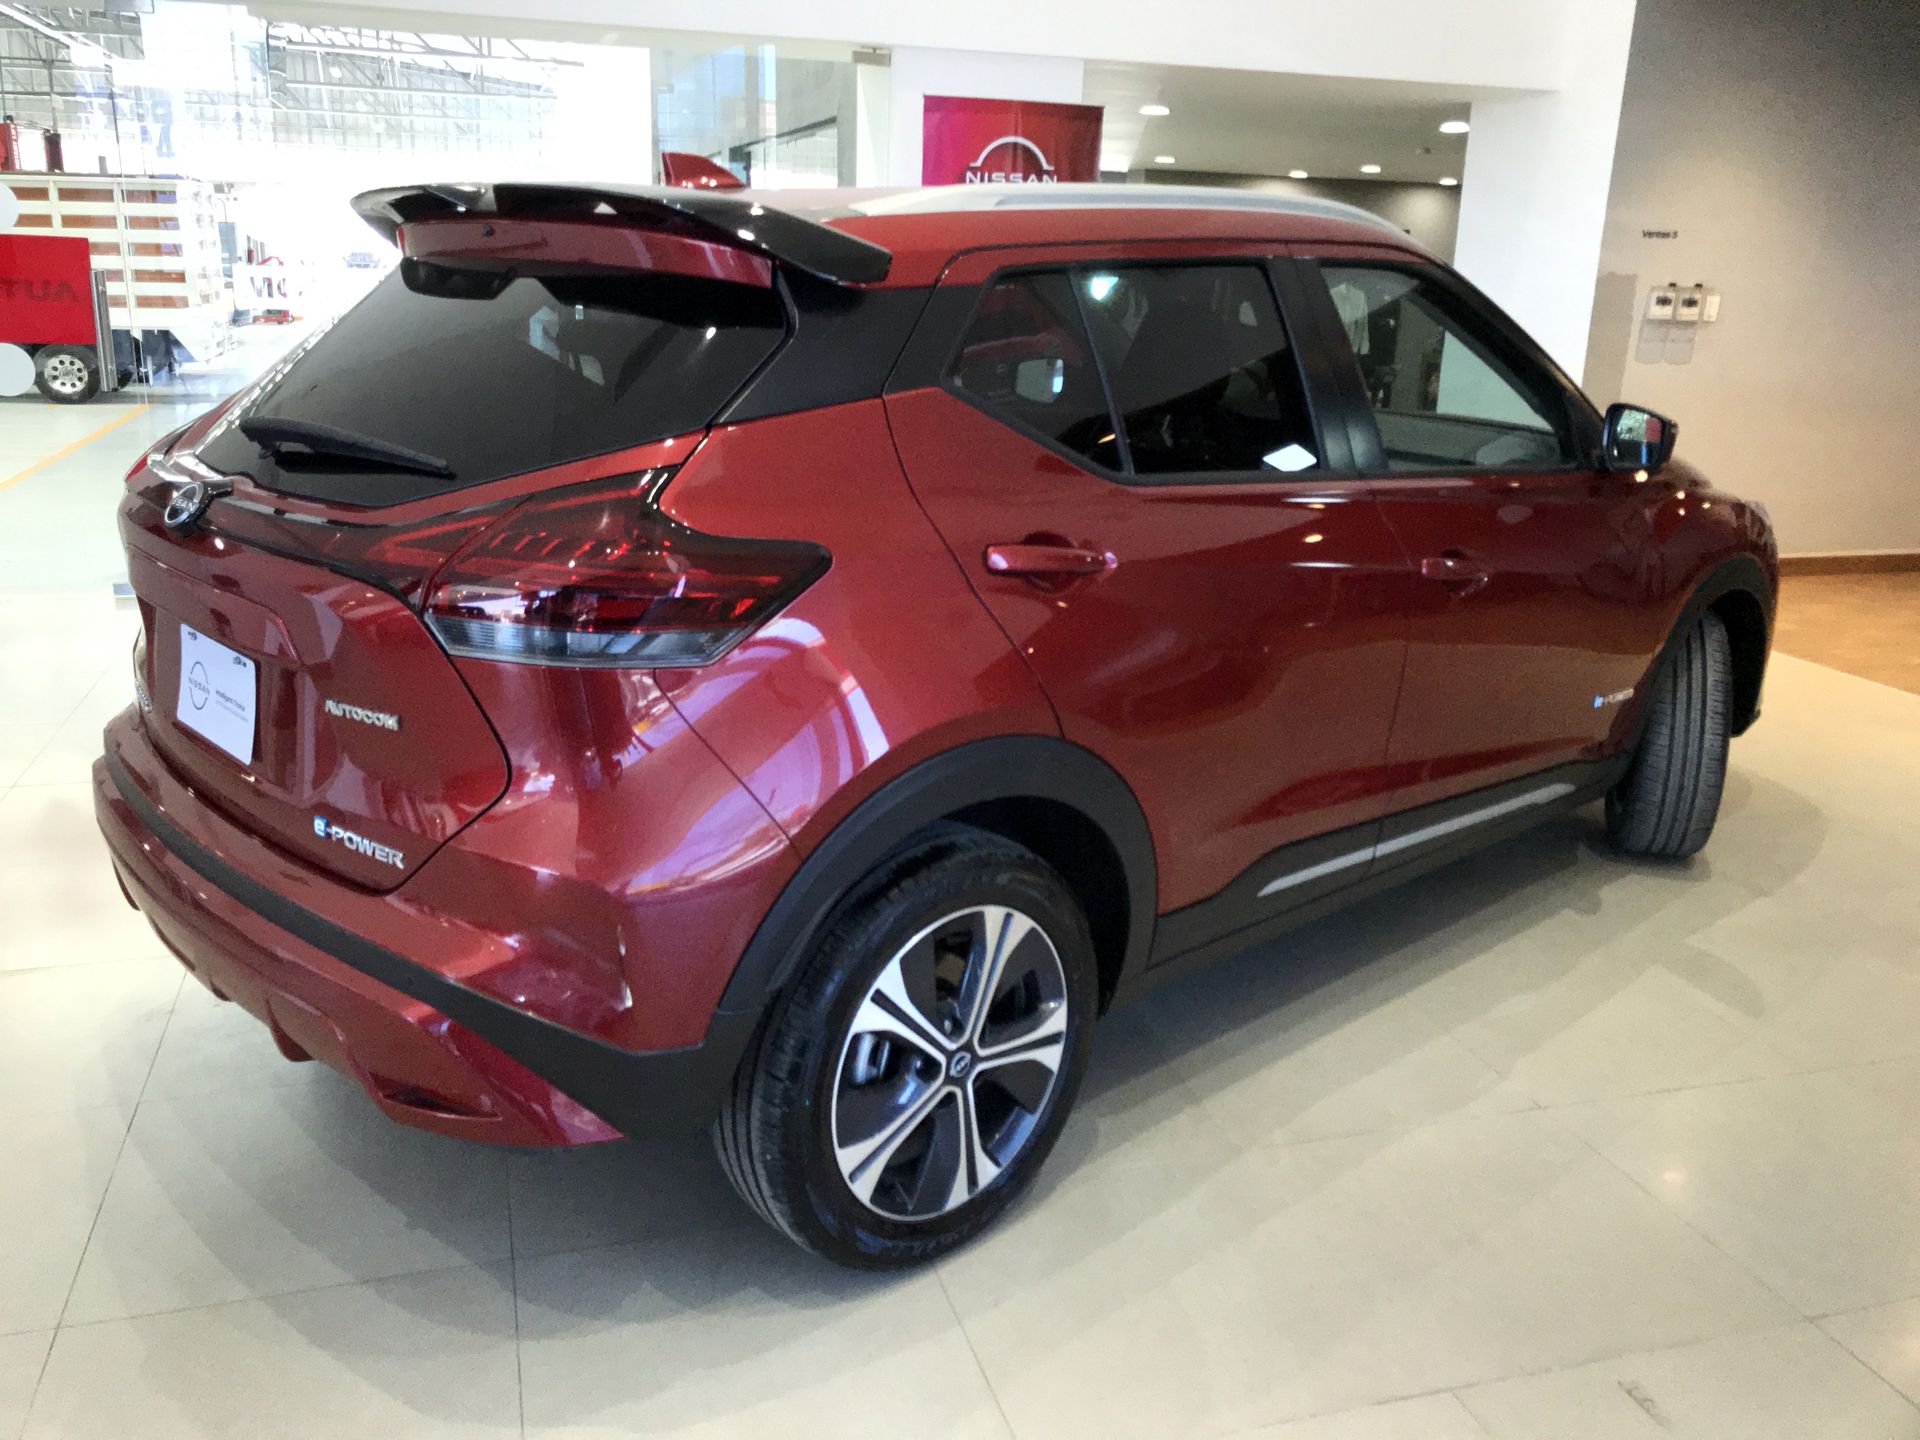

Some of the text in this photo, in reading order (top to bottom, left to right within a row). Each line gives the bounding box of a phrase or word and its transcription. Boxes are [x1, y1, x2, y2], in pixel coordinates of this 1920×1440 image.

[965, 170, 1057, 185] NISSAN
[187, 675, 211, 696] NISSAN
[324, 698, 400, 732] AUTOCOM
[313, 815, 405, 870] e-POWER
